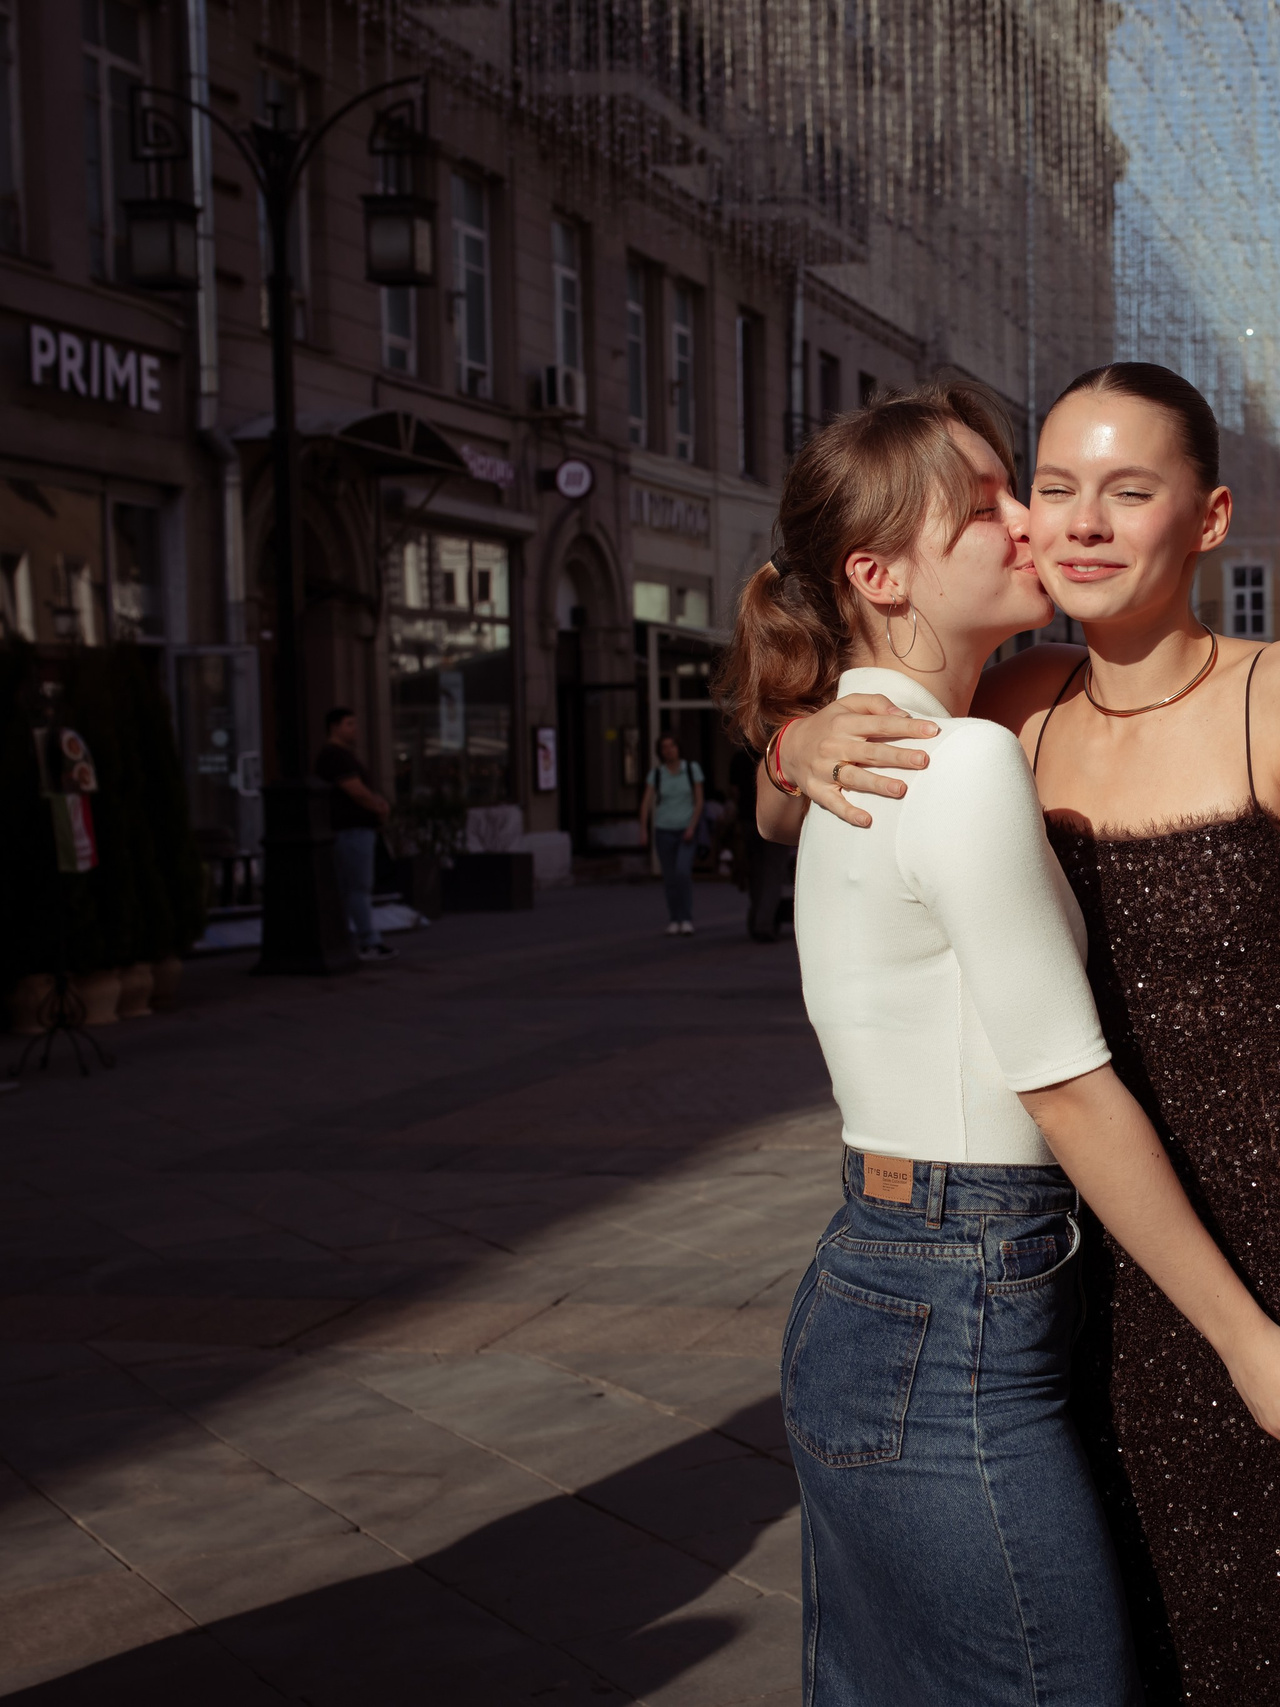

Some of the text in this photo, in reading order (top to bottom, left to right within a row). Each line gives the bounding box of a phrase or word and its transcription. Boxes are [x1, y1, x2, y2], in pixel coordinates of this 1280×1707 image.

[29, 323, 161, 414] PRIME
[867, 1166, 908, 1180] IT'S BASIC
